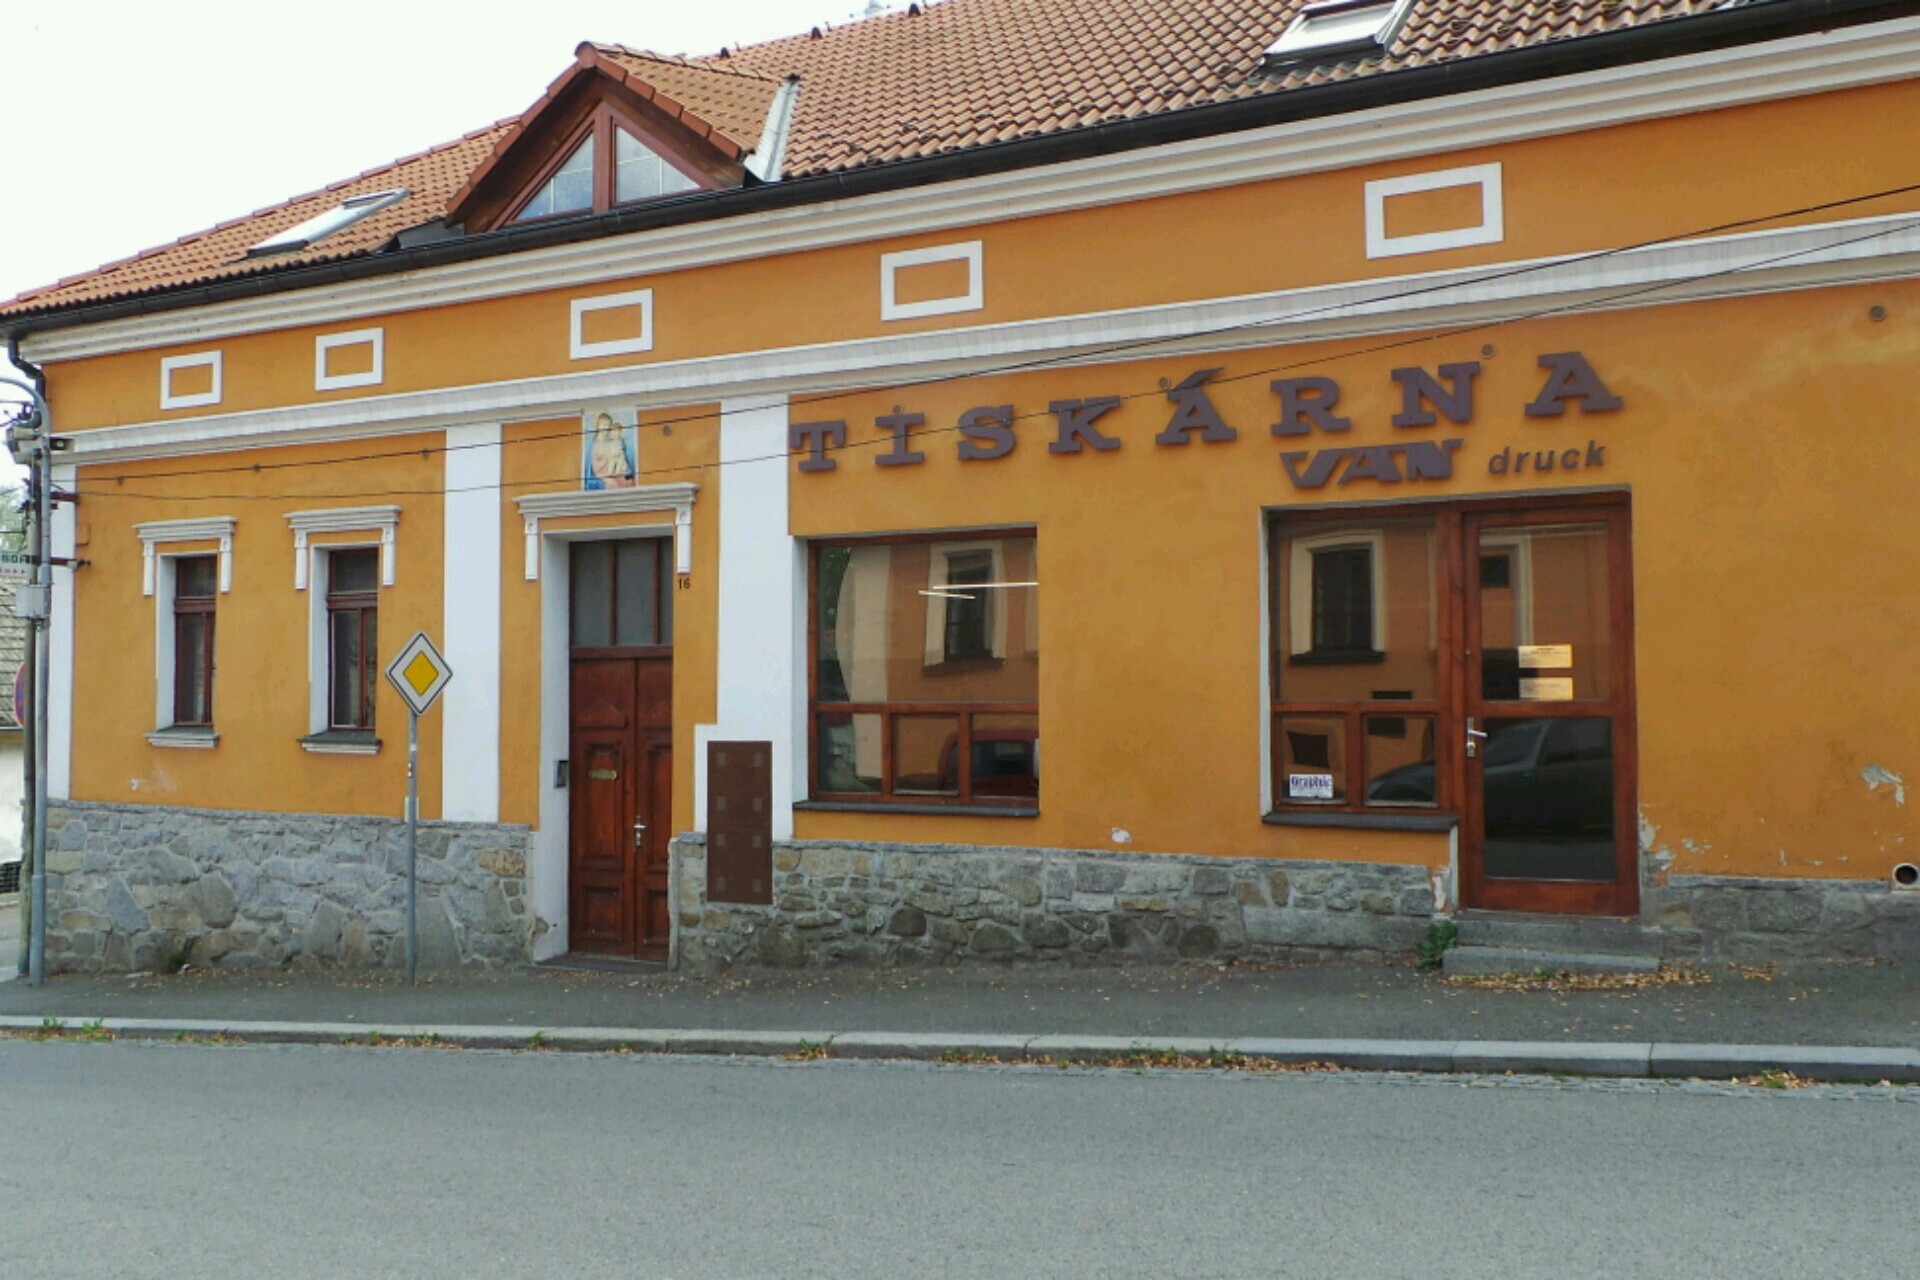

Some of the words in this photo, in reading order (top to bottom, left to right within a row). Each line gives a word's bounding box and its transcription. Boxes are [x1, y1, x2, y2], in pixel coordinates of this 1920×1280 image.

[789, 351, 1623, 472] TISKÁRNA
[1279, 438, 1464, 488] VAN
[1487, 439, 1607, 475] druck
[679, 577, 690, 590] 16
